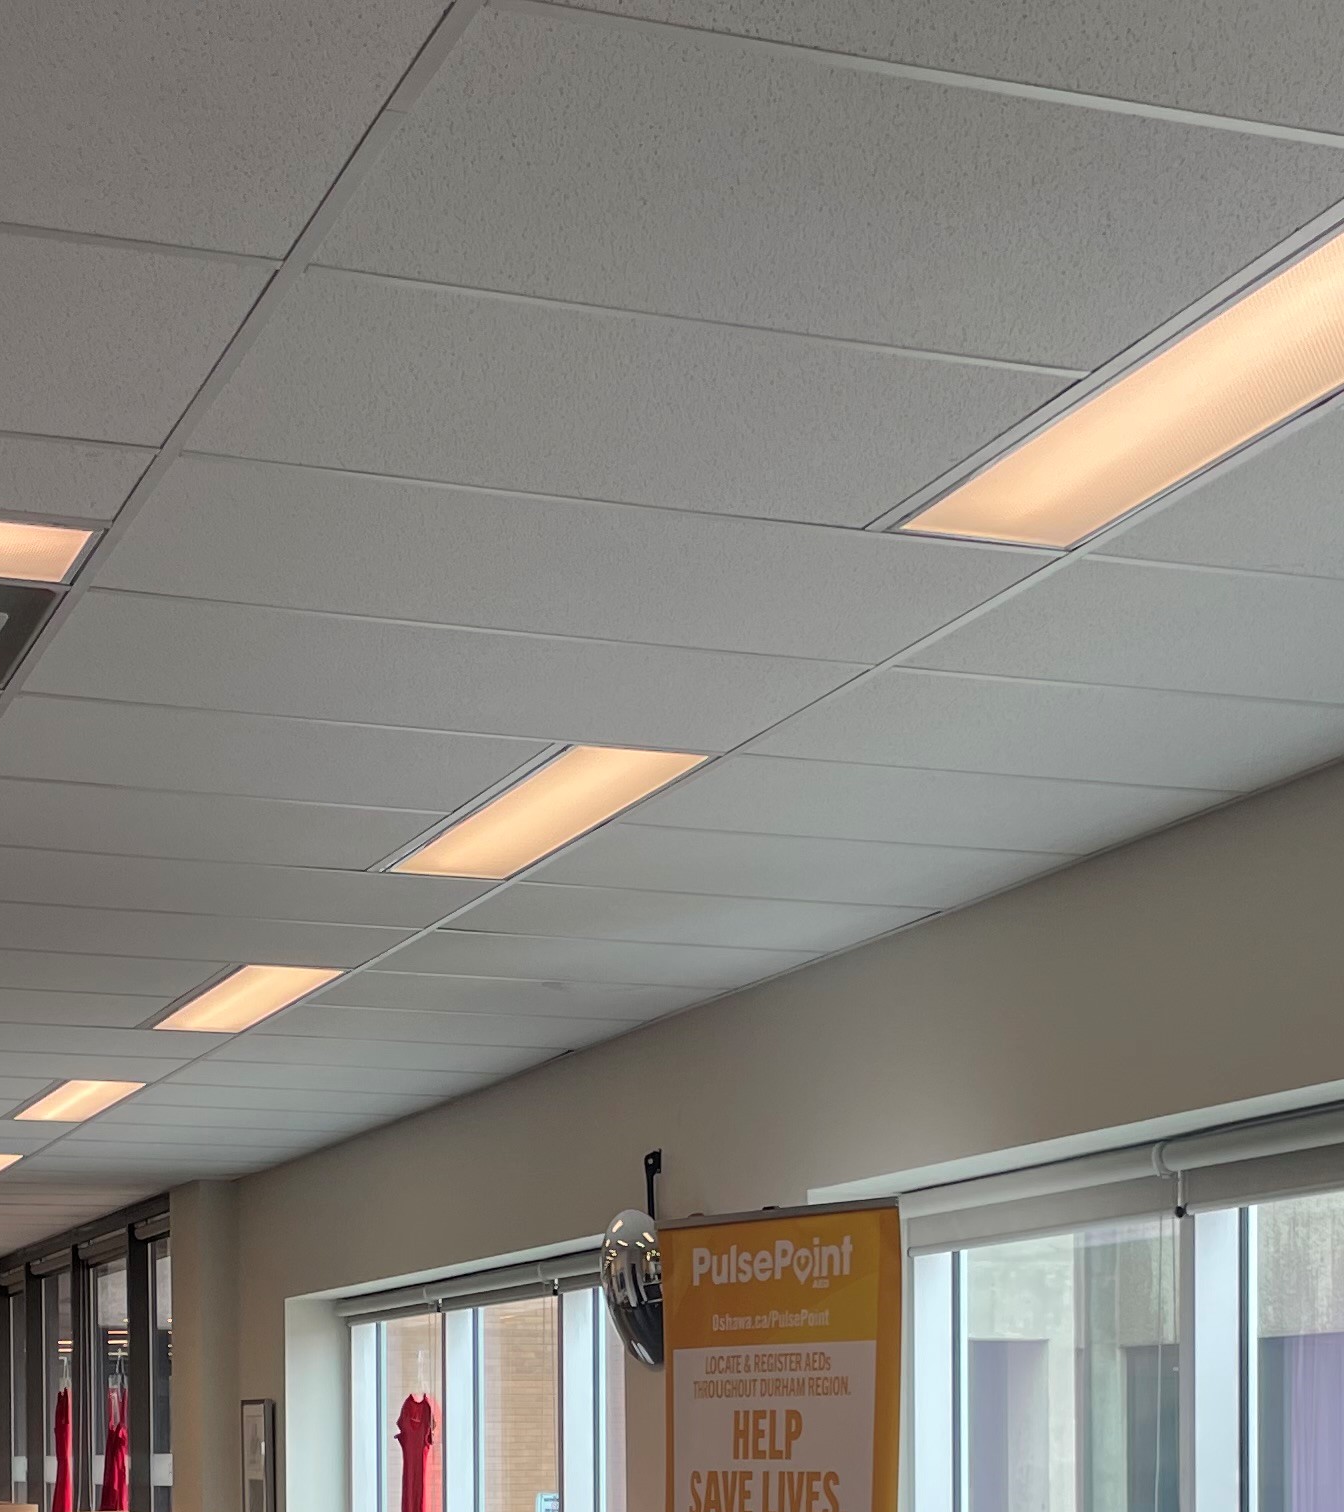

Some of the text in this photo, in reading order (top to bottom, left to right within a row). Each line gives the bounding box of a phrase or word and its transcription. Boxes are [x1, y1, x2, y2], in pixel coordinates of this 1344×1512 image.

[692, 1235, 853, 1286] PulsePoint
[712, 1308, 830, 1332] Oshawa.ca/PulsePoint
[706, 1351, 831, 1374] LOCATE & REGISTER AEDs
[693, 1375, 852, 1400] THROUGHOUT DURHAM REGION.
[733, 1409, 804, 1461] HELP
